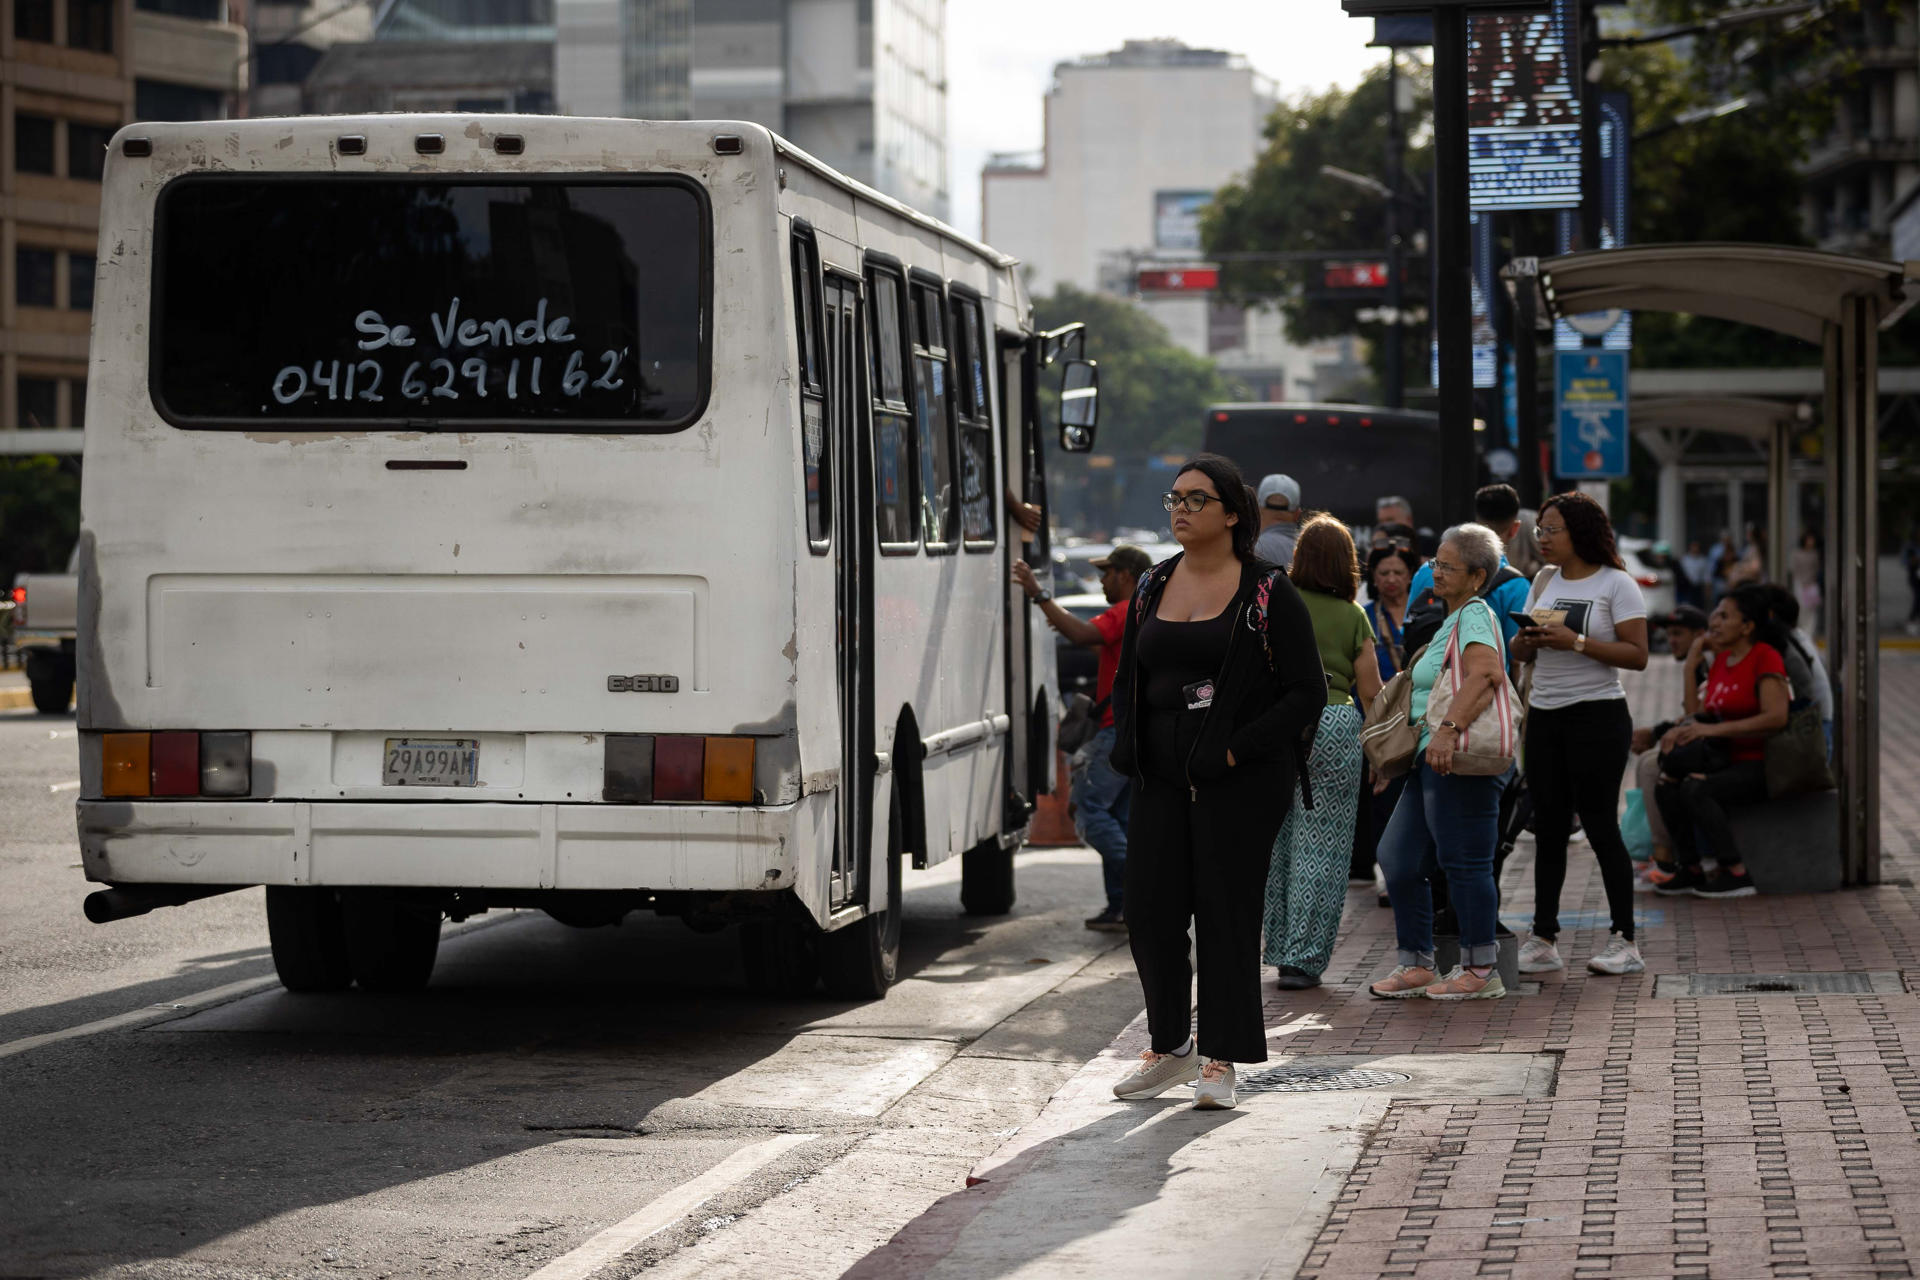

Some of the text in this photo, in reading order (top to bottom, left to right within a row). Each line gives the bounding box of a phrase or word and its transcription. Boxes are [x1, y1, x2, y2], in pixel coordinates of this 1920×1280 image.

[355, 297, 576, 350] Se Vende
[273, 359, 383, 404] 0412
[402, 358, 487, 399] 629
[563, 350, 624, 397] 62
[388, 750, 473, 775] 29A99AM
